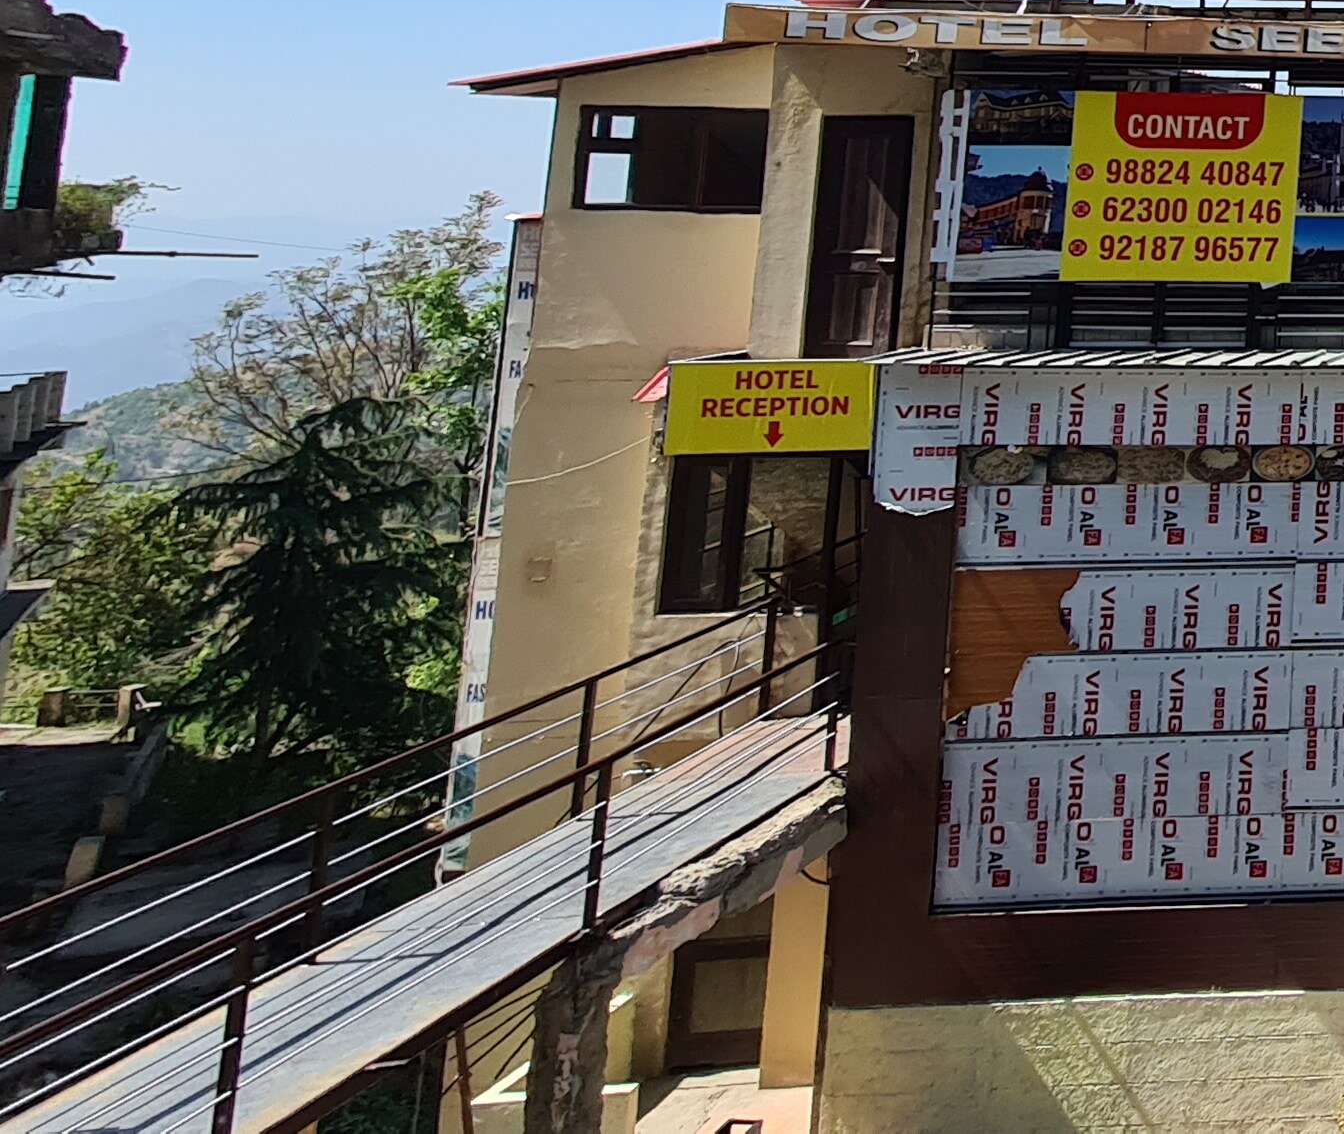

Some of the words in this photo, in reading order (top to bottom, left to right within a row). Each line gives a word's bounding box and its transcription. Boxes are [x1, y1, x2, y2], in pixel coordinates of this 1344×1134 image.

[783, 11, 1087, 46] HOTEL
[1127, 114, 1250, 140] CONTACT
[1106, 159, 1190, 185] 98824
[1200, 161, 1284, 186] 40847
[1103, 197, 1187, 223] 62300
[1197, 198, 1282, 224] 02146
[1099, 235, 1185, 261] 92187
[1194, 236, 1279, 262] 96577
[735, 369, 819, 390] HOTEL
[701, 396, 850, 418] RECEPTION
